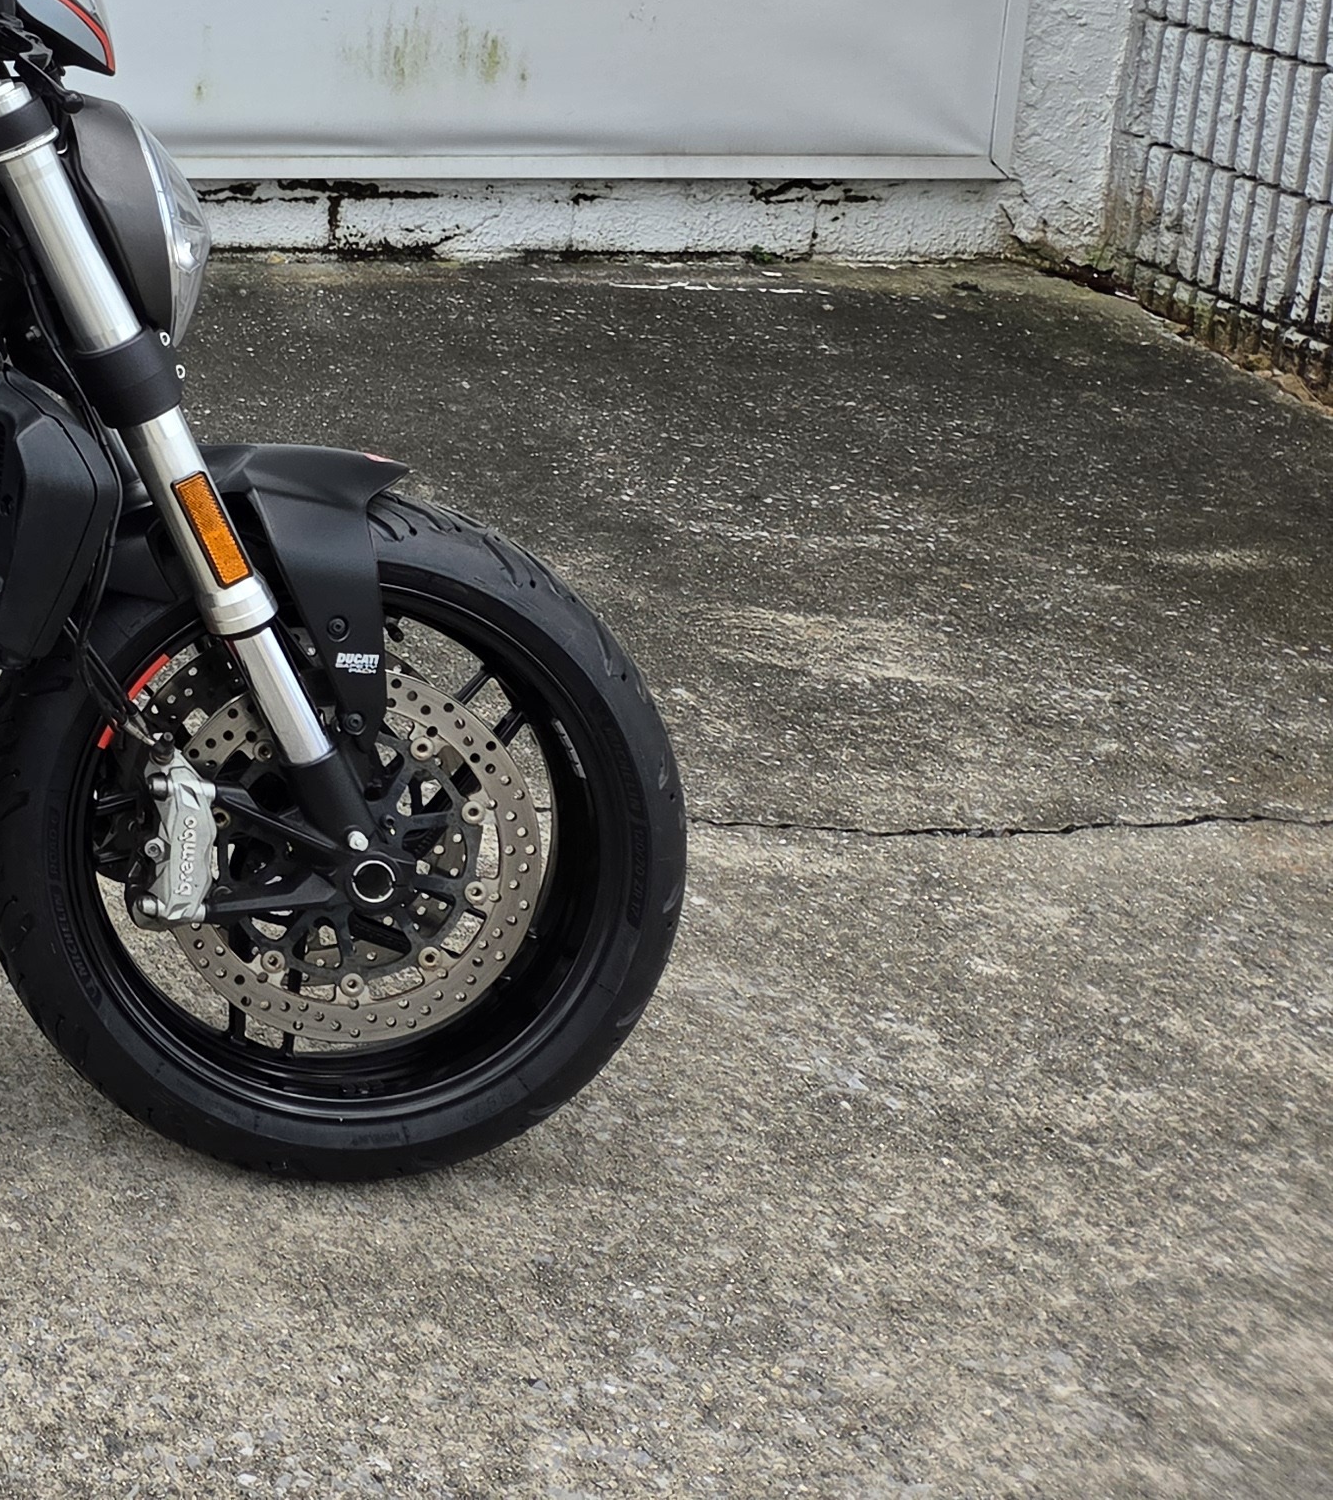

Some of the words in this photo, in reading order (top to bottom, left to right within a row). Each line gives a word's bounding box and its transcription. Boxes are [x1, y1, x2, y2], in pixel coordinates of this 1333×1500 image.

[336, 652, 380, 666] DUCATI
[173, 815, 198, 896] brembo
[52, 892, 88, 978] MICHELIN
